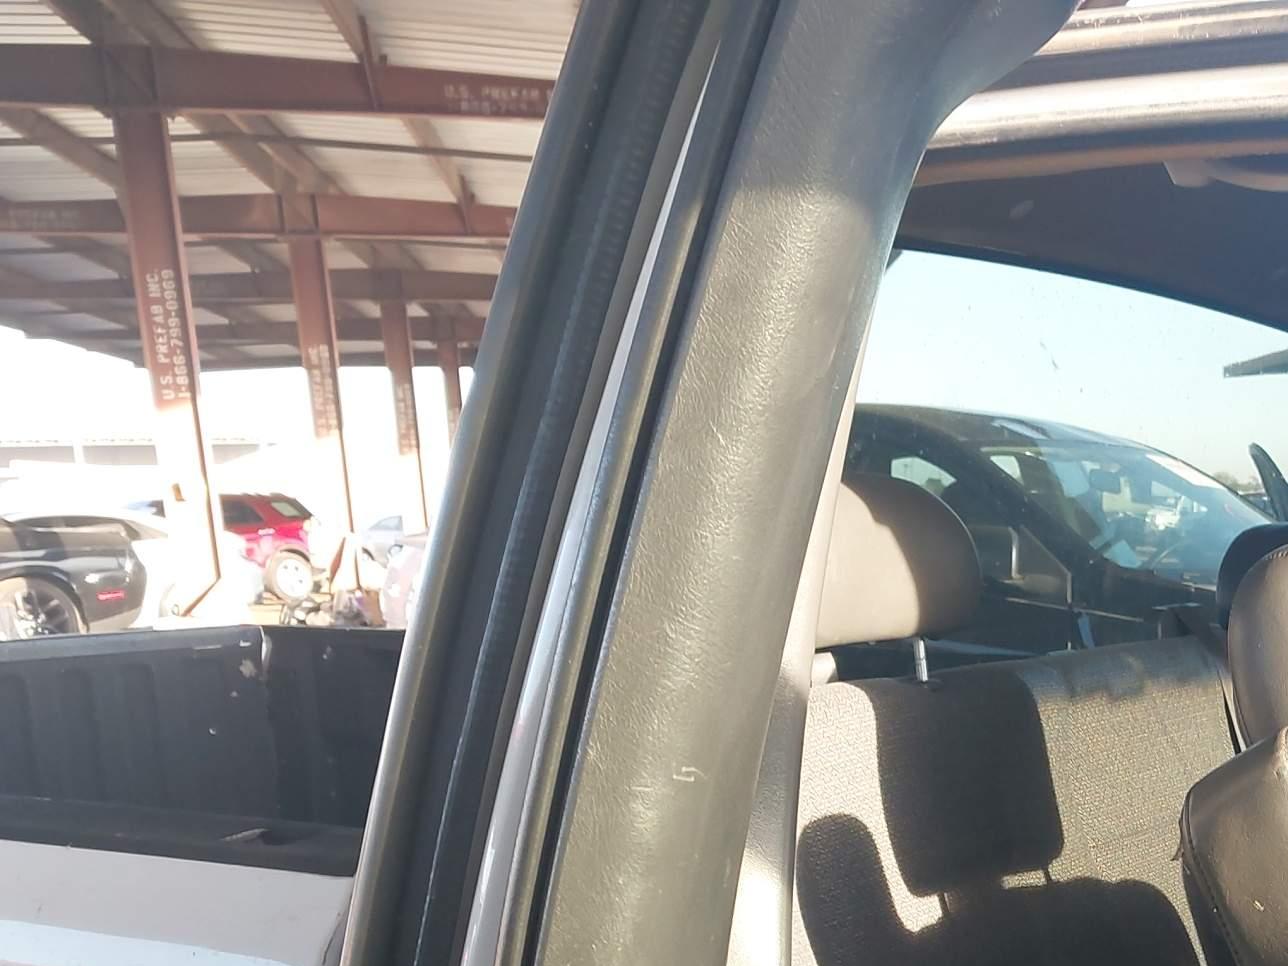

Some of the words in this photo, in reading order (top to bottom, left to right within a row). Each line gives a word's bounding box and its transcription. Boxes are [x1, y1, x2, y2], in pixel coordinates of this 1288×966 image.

[146, 269, 161, 298] INC.
[151, 304, 171, 364] PREFAB
[160, 269, 192, 399] 1-866-799-0969
[160, 370, 176, 400] U.S.
